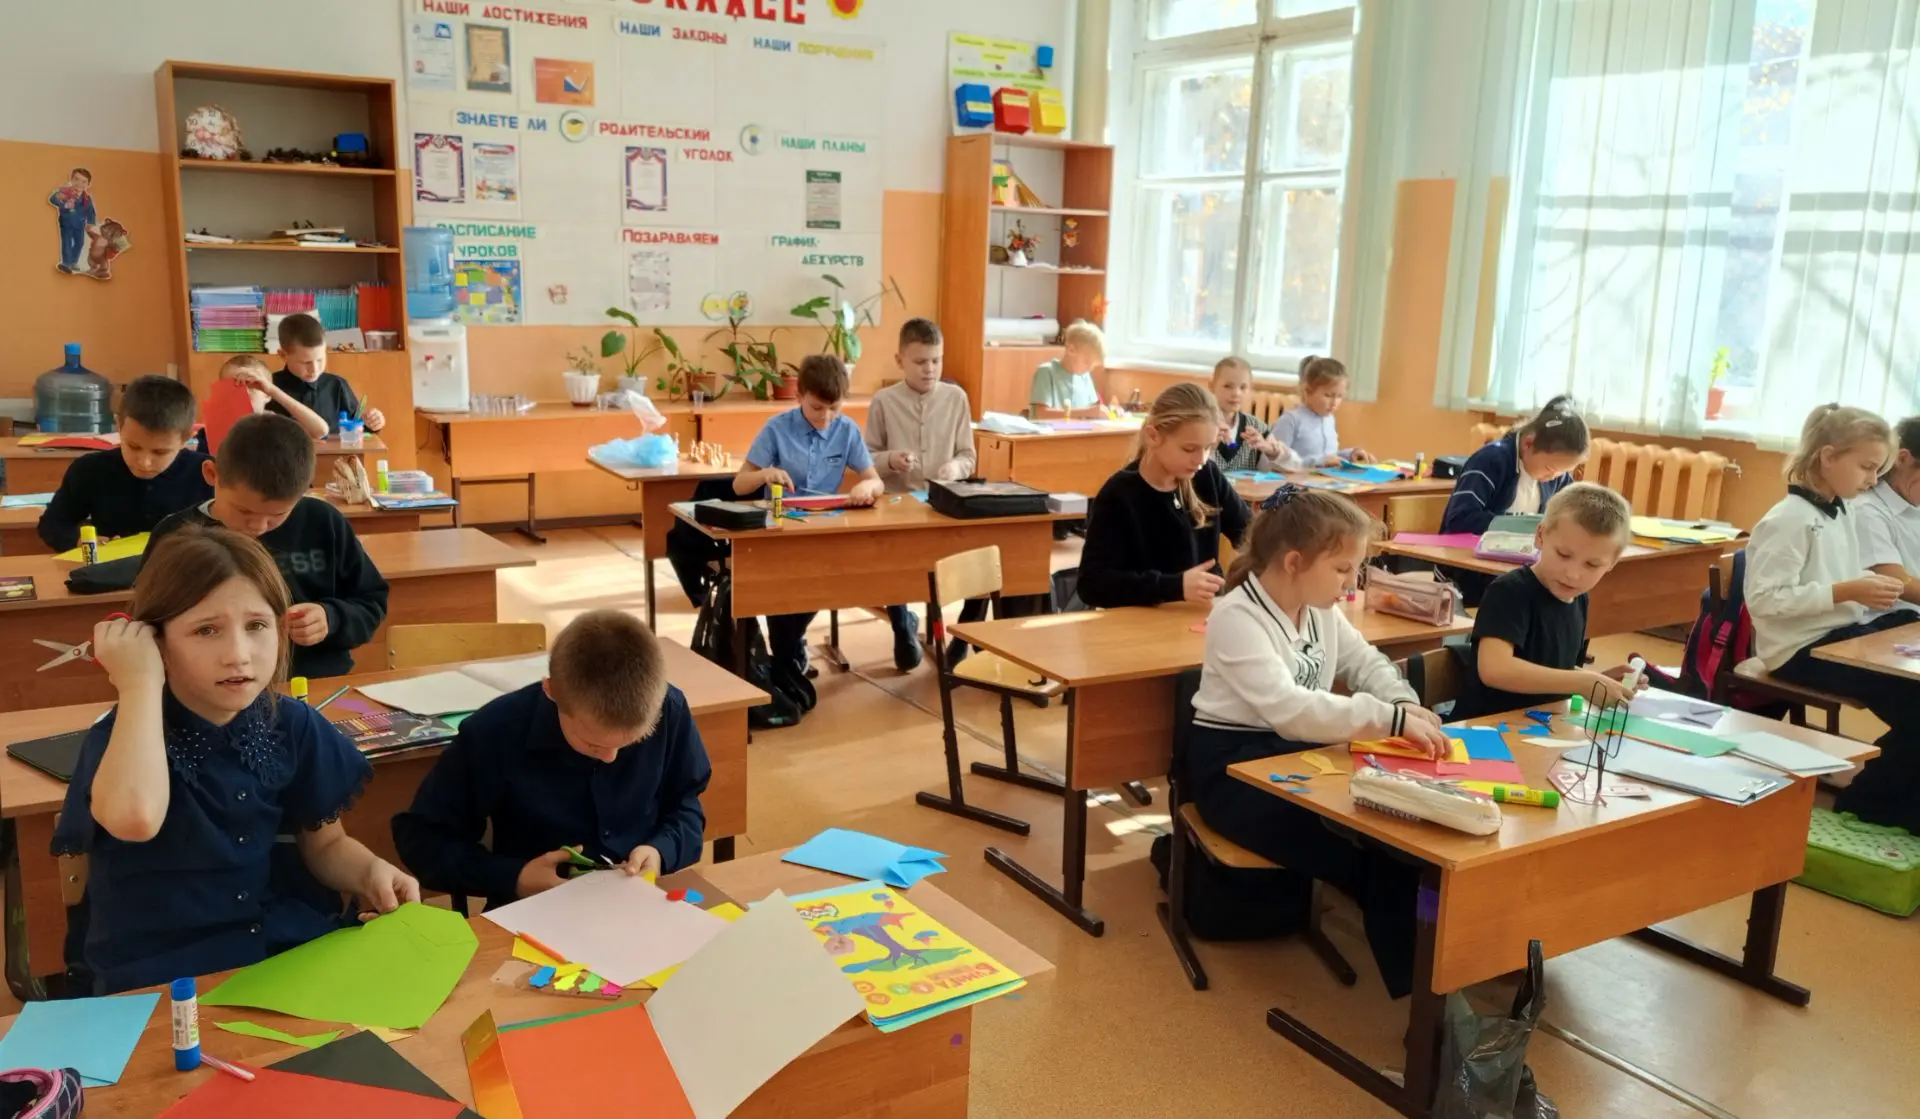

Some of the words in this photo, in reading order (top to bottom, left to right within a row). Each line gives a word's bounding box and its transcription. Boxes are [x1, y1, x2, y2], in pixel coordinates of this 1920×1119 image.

[423, 0, 469, 16] НАШИ
[482, 4, 588, 29] ДОСТИЖЕНИЯ
[620, 21, 661, 37] НАШИ
[672, 27, 728, 45] ЗАКОНЫ
[753, 37, 792, 52] НАШИ
[456, 111, 518, 129] ЗНАЕТЕ
[528, 118, 547, 131] ЛИ
[600, 122, 710, 141] РОДИТЕЛЬСКИЙ
[781, 136, 816, 150] НАШИ
[822, 140, 866, 153] ПЛАНЫ
[683, 148, 734, 162] УГОЛОК
[622, 229, 719, 245] ПОЗДРАВЛЯЕМ
[458, 245, 518, 257] УРОКОВ
[801, 254, 865, 267] ДЕЖУРСТВ
